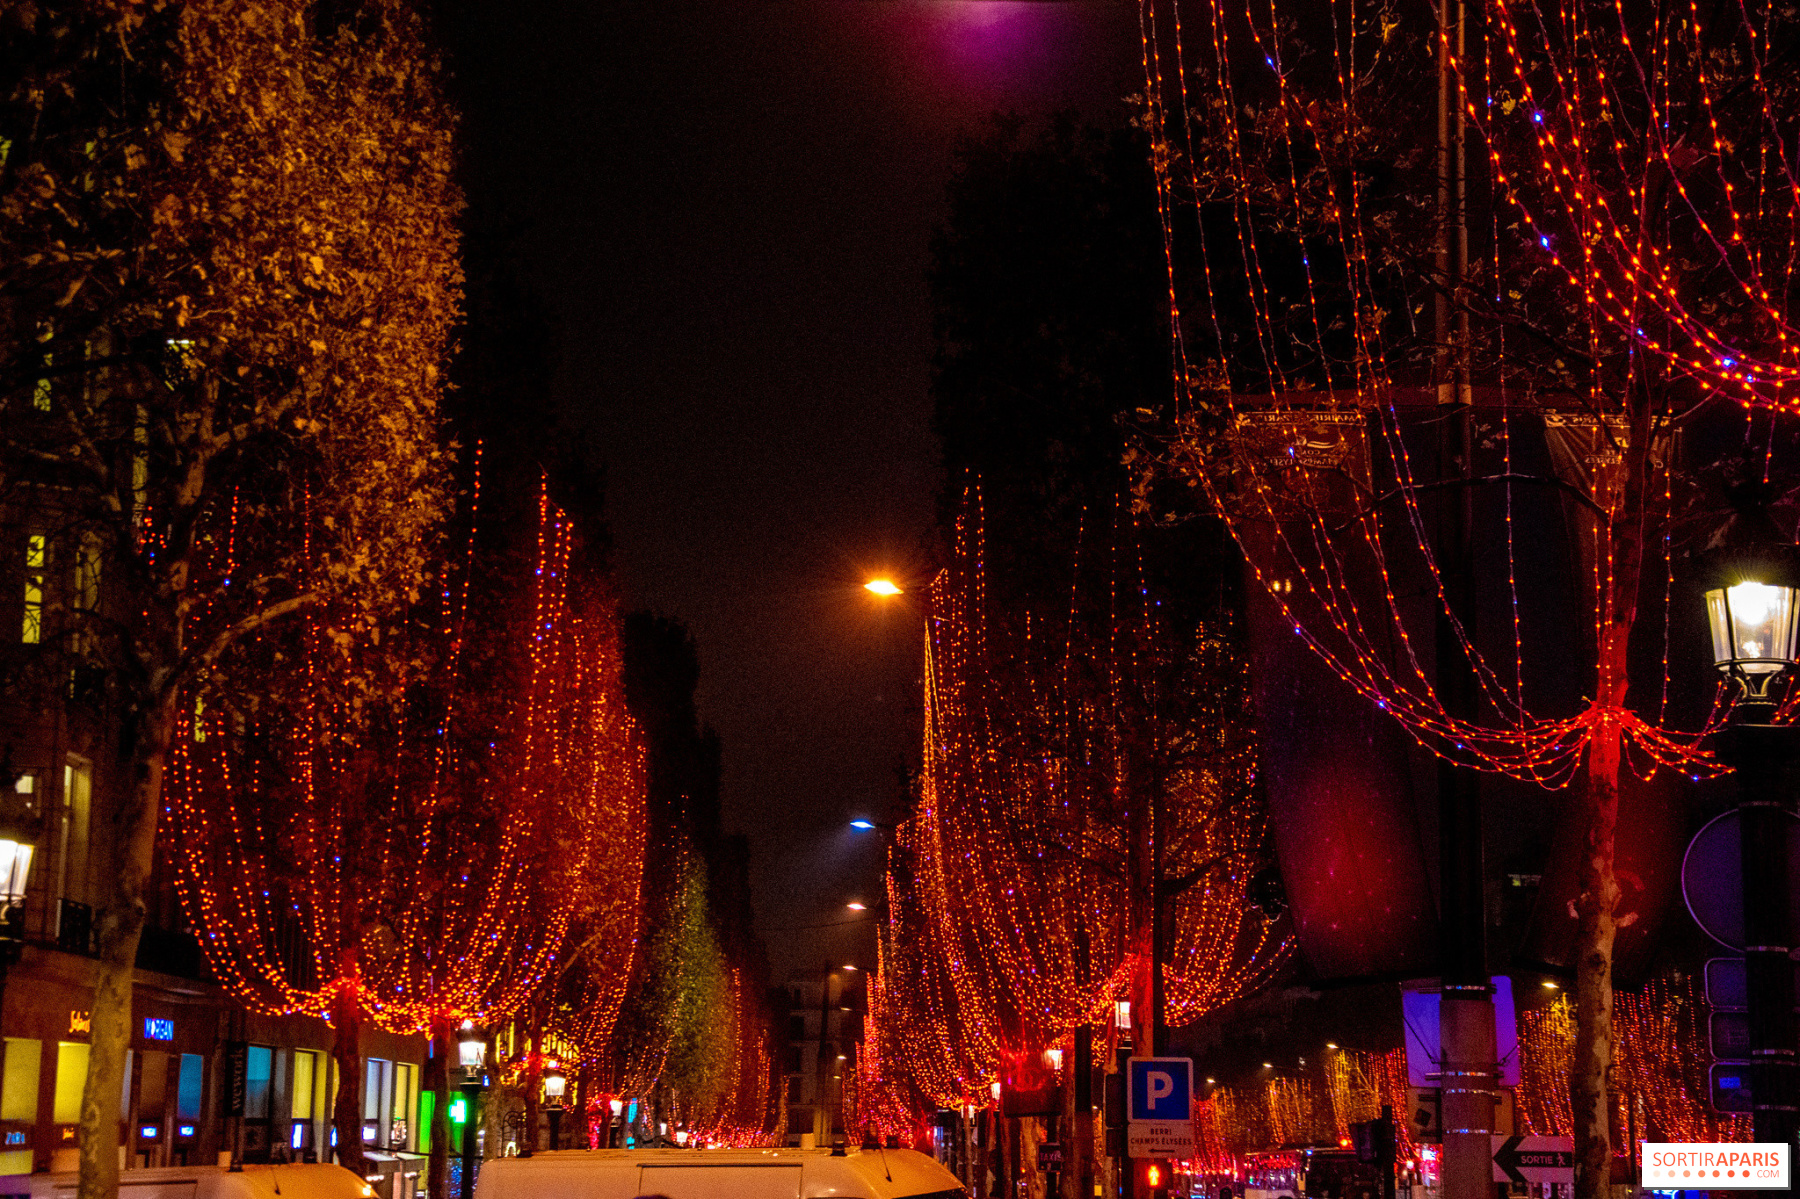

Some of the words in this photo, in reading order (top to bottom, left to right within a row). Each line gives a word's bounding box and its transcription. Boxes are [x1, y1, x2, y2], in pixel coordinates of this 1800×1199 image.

[232, 1047, 244, 1112] wework
[1147, 1071, 1174, 1110] P
[1150, 1128, 1172, 1136] BERRI
[1130, 1137, 1160, 1146] CHAMPS
[1521, 1155, 1554, 1165] SORTIE
